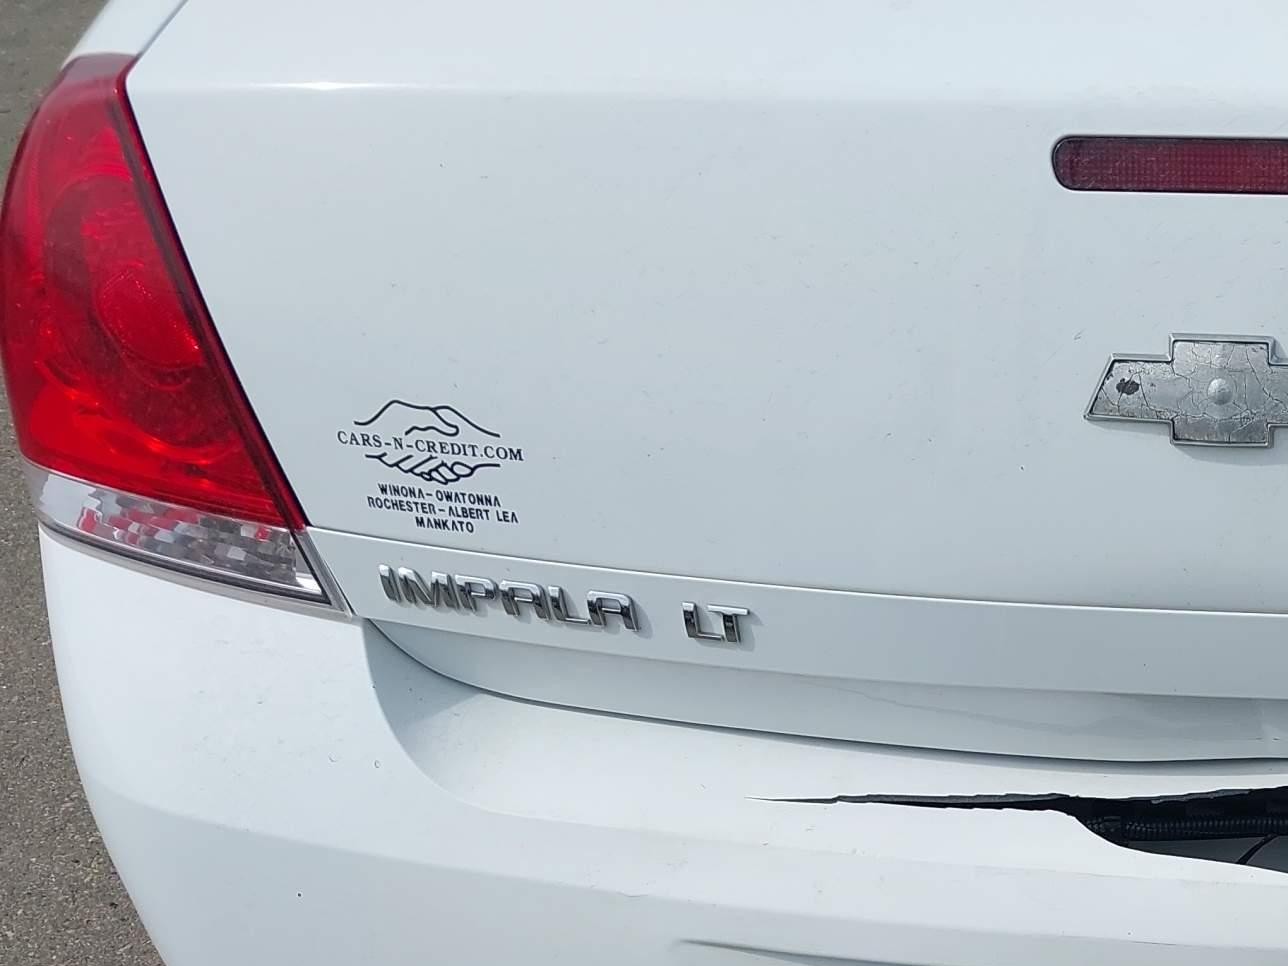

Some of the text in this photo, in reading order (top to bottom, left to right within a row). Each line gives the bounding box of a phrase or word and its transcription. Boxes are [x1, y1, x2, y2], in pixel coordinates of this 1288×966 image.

[337, 431, 524, 461] CARS-N-CREDIT.COM
[415, 516, 475, 533] MANKATO
[496, 511, 519, 524] LEA
[378, 564, 750, 644] IMPALA LT
